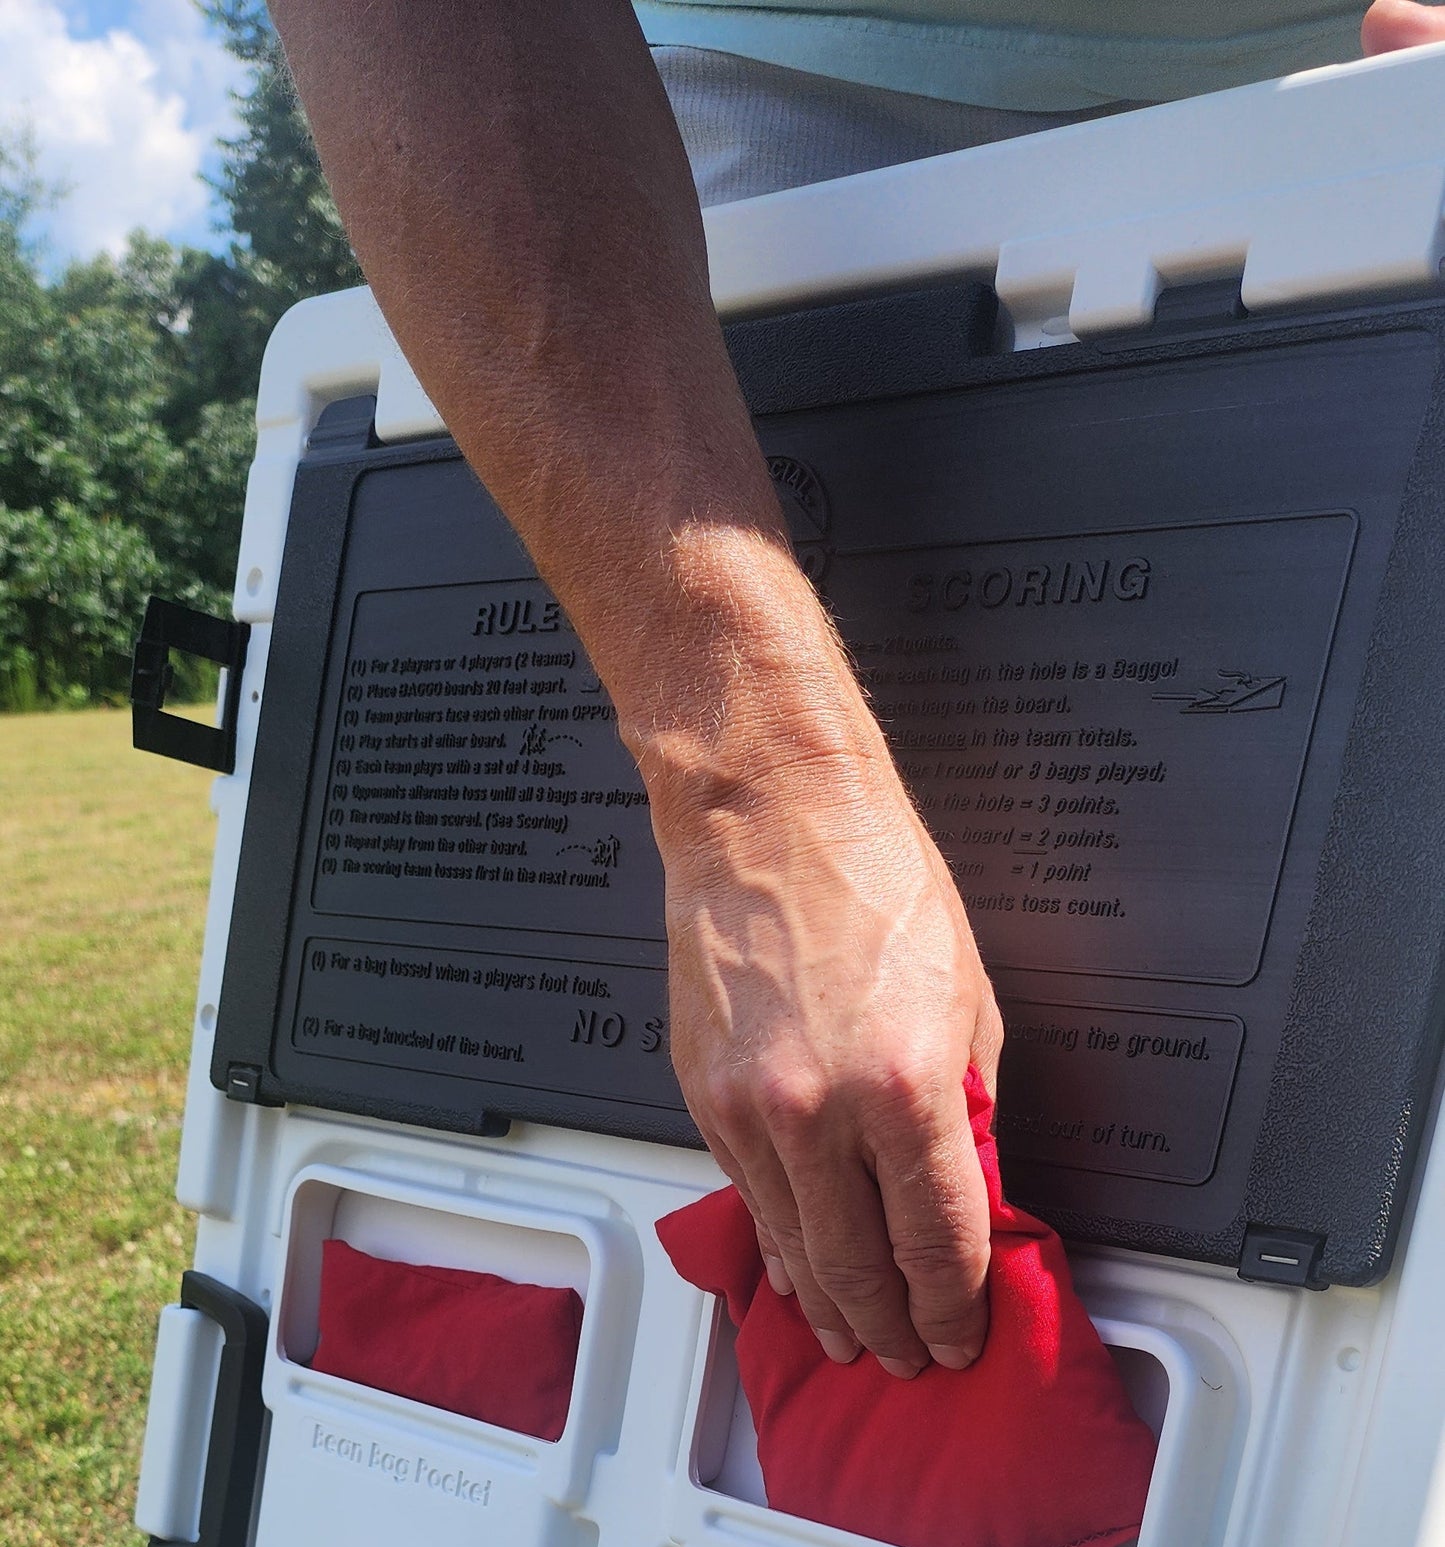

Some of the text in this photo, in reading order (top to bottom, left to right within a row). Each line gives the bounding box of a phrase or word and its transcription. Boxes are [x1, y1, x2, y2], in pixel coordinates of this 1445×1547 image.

[905, 556, 1152, 613] SCORING
[472, 600, 572, 636] RULE
[351, 651, 575, 677] (1) For 2 players or 4 players (2 teams)
[942, 665, 970, 685] bag
[976, 665, 991, 681] in
[998, 663, 1024, 681] the
[1030, 661, 1066, 680] hole
[1072, 660, 1088, 679] is
[1095, 665, 1105, 680] a
[1112, 658, 1179, 682] Baggo!
[348, 678, 567, 702] (2) Place BAGGO boards 20 feet apart.
[921, 698, 948, 718] bag
[955, 700, 976, 714] on
[982, 696, 1008, 714] the
[1013, 695, 1071, 714] board.
[971, 728, 1137, 748] in the team totals.
[355, 760, 381, 774] Each
[384, 760, 412, 774] team
[413, 760, 443, 777] plays
[446, 760, 471, 774] with
[474, 762, 481, 774] a
[484, 760, 503, 774] set
[506, 760, 519, 774] of
[522, 760, 530, 775] 4
[533, 760, 565, 778] bags.
[945, 762, 1167, 785] round or 8 bags played;
[942, 794, 1120, 817] the hole 3 points.
[961, 826, 1120, 850] board 2 points.
[1043, 861, 1092, 884] point
[1020, 894, 1126, 920] toss count.
[312, 950, 611, 998] (1) For a bag tossed when a players foot fouls.
[303, 1016, 525, 1062] (2) For a bag knocked off the board.
[570, 1008, 625, 1048] NO
[1087, 1026, 1210, 1061] the ground.
[1048, 1119, 1171, 1153] out of turn.
[312, 1423, 492, 1507] Bean Bag Pocket
